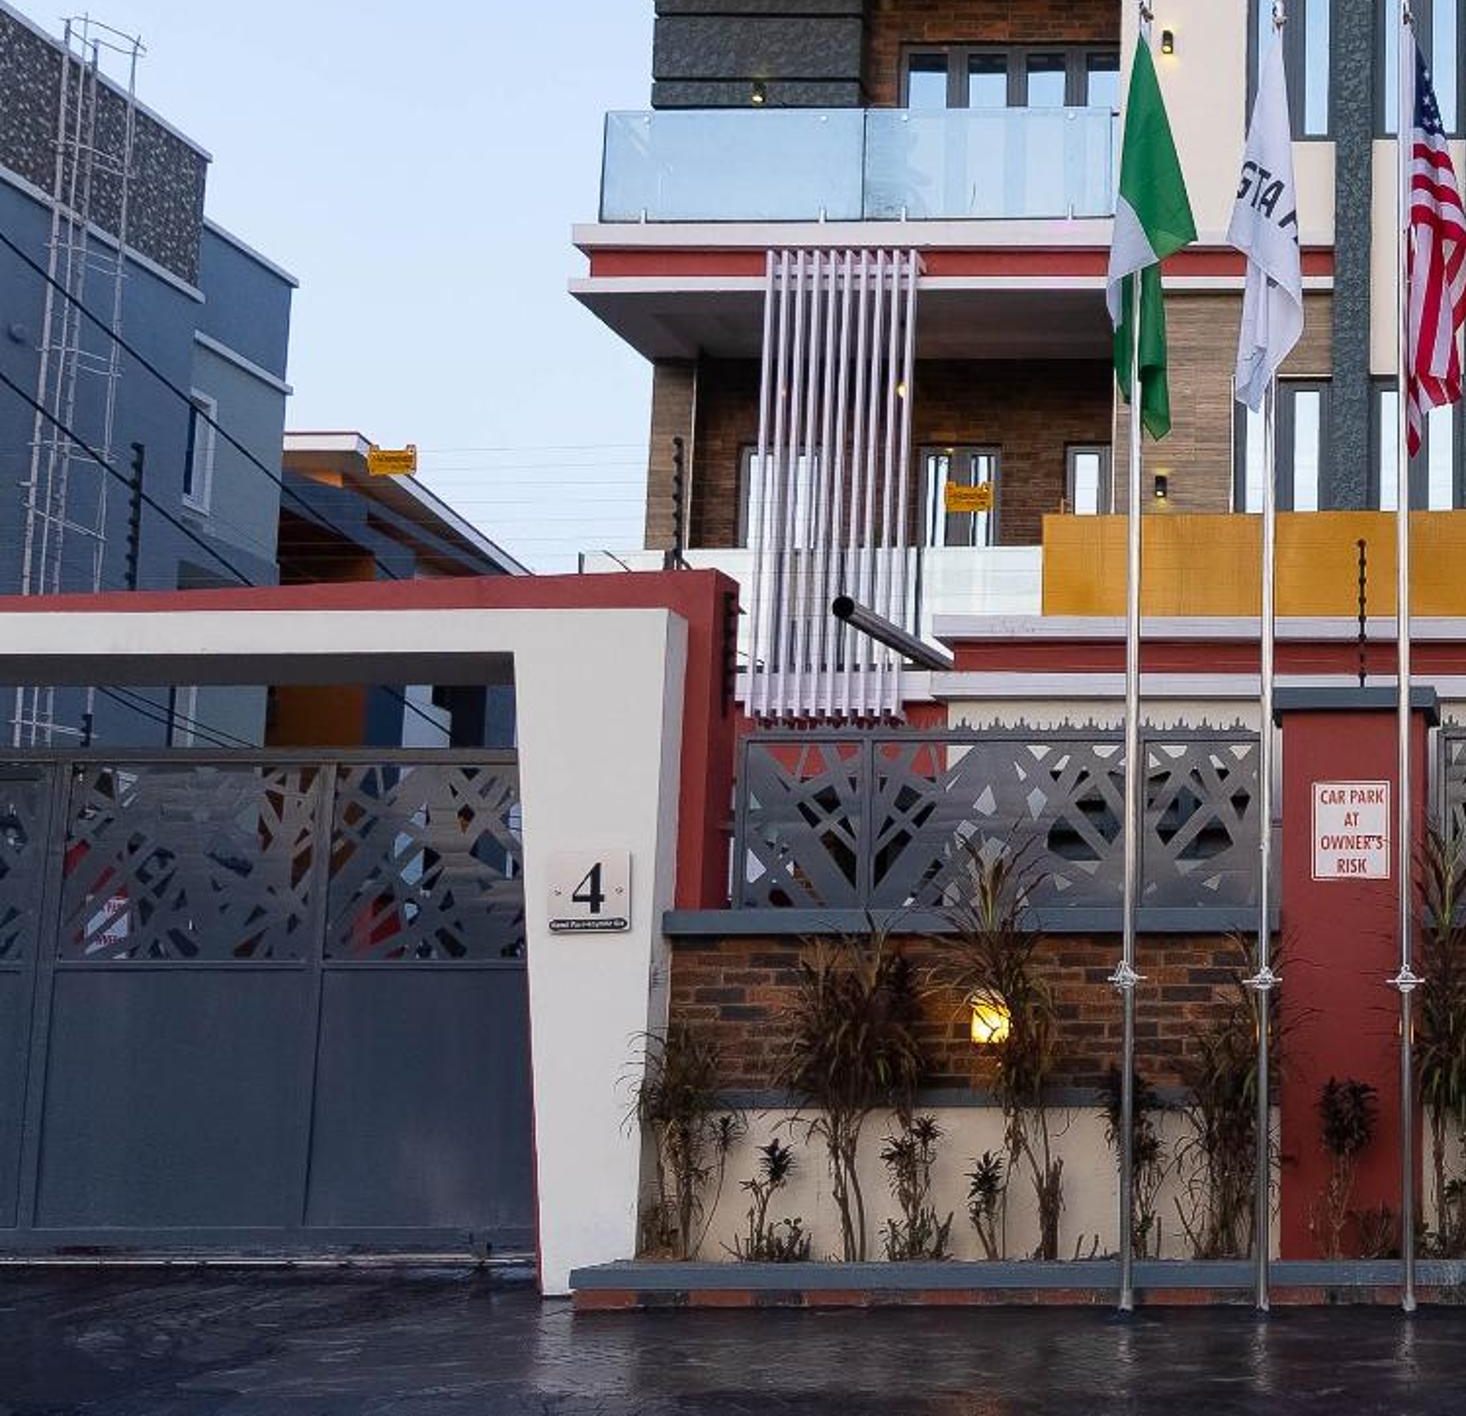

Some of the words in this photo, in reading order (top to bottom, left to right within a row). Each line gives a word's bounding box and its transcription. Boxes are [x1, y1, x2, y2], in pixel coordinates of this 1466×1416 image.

[1320, 790, 1346, 805] CAR
[1350, 789, 1385, 804] PARK
[1344, 812, 1360, 827] AT
[1336, 858, 1368, 873] RISK
[572, 862, 605, 914] 4
